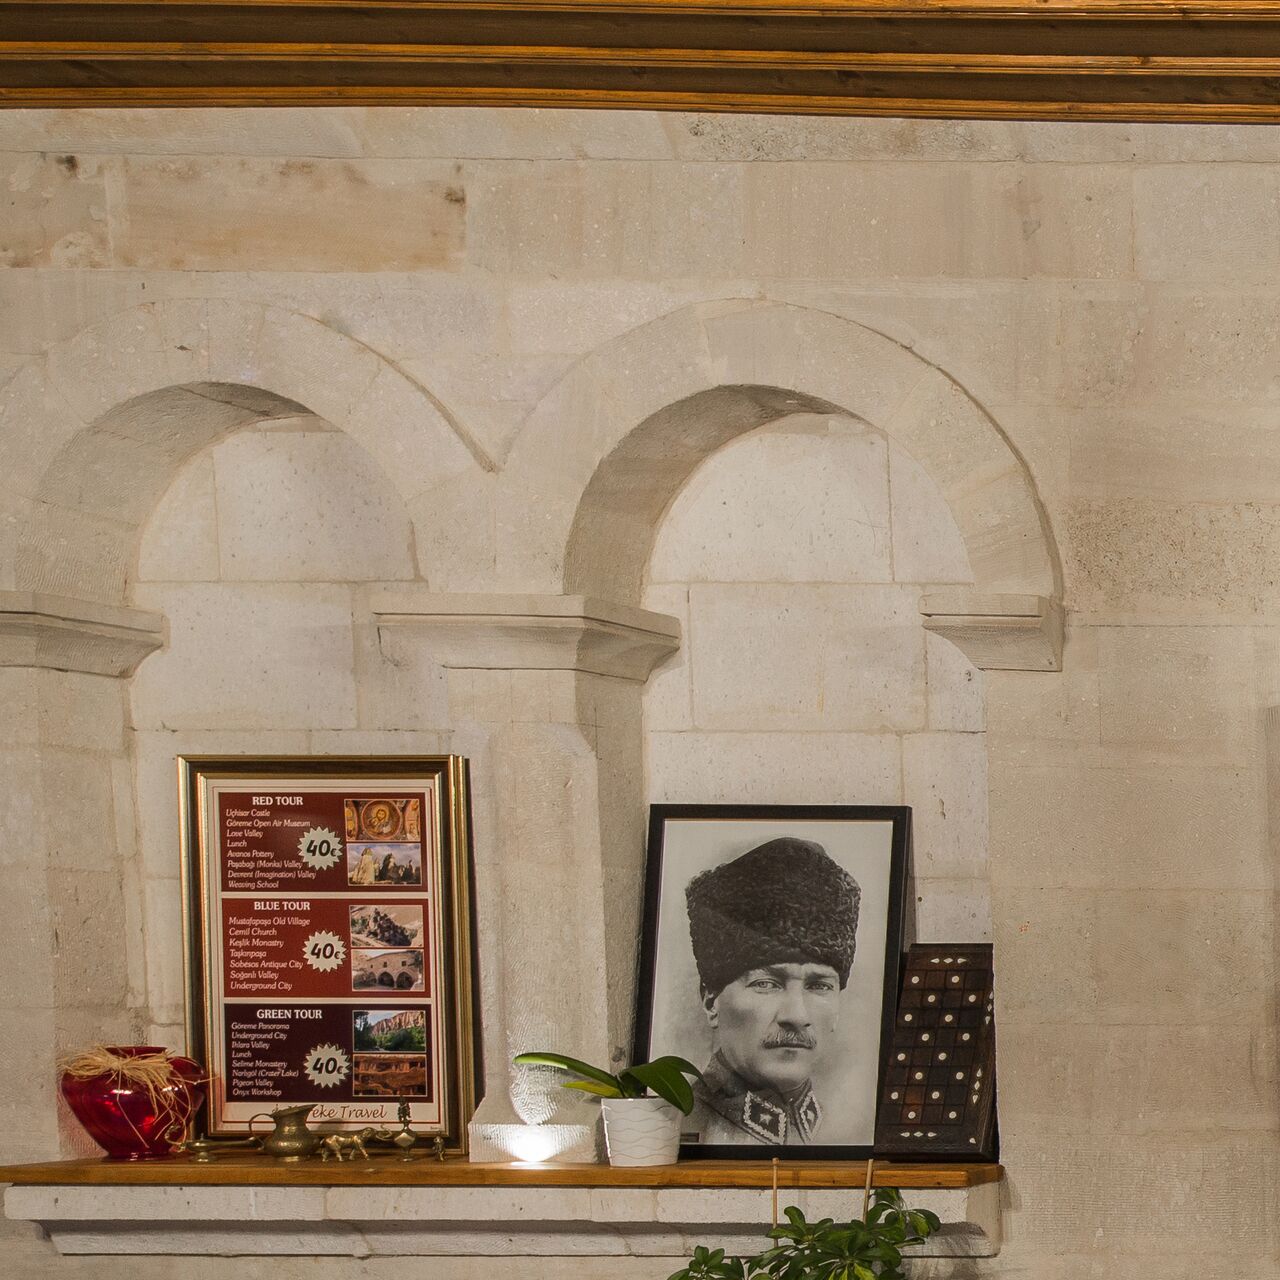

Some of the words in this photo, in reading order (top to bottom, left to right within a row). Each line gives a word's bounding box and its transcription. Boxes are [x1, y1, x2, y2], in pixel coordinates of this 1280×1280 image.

[252, 796, 273, 805] RED
[276, 796, 303, 805] TOUR
[251, 809, 270, 817] Castle
[254, 820, 271, 829] Open
[244, 830, 263, 838] Valley
[252, 850, 274, 859] Pottery
[284, 860, 303, 869] Valley
[255, 871, 296, 879] (Imagination)
[297, 871, 316, 879] Valley
[254, 901, 279, 910] BLUE
[282, 901, 310, 910] TOUR
[273, 917, 286, 925] Old
[287, 917, 310, 926] Village
[252, 928, 277, 936] Church
[260, 960, 287, 969] Antique
[289, 960, 303, 969] City
[258, 971, 279, 980] Valley
[231, 982, 276, 991] Underground
[278, 982, 292, 991] City
[257, 1009, 292, 1019] GREEN
[294, 1009, 322, 1019] TOUR
[258, 1022, 289, 1030] Panorama
[232, 1032, 273, 1040] Underground
[274, 1032, 287, 1040] City
[251, 1042, 270, 1050] Valley
[255, 1061, 287, 1069] Monastery
[232, 1079, 254, 1087] Pigeon
[255, 1079, 273, 1087] Valley
[233, 1089, 250, 1097] Onyx
[252, 1089, 281, 1097] Workshop
[341, 1105, 386, 1119] Travel
